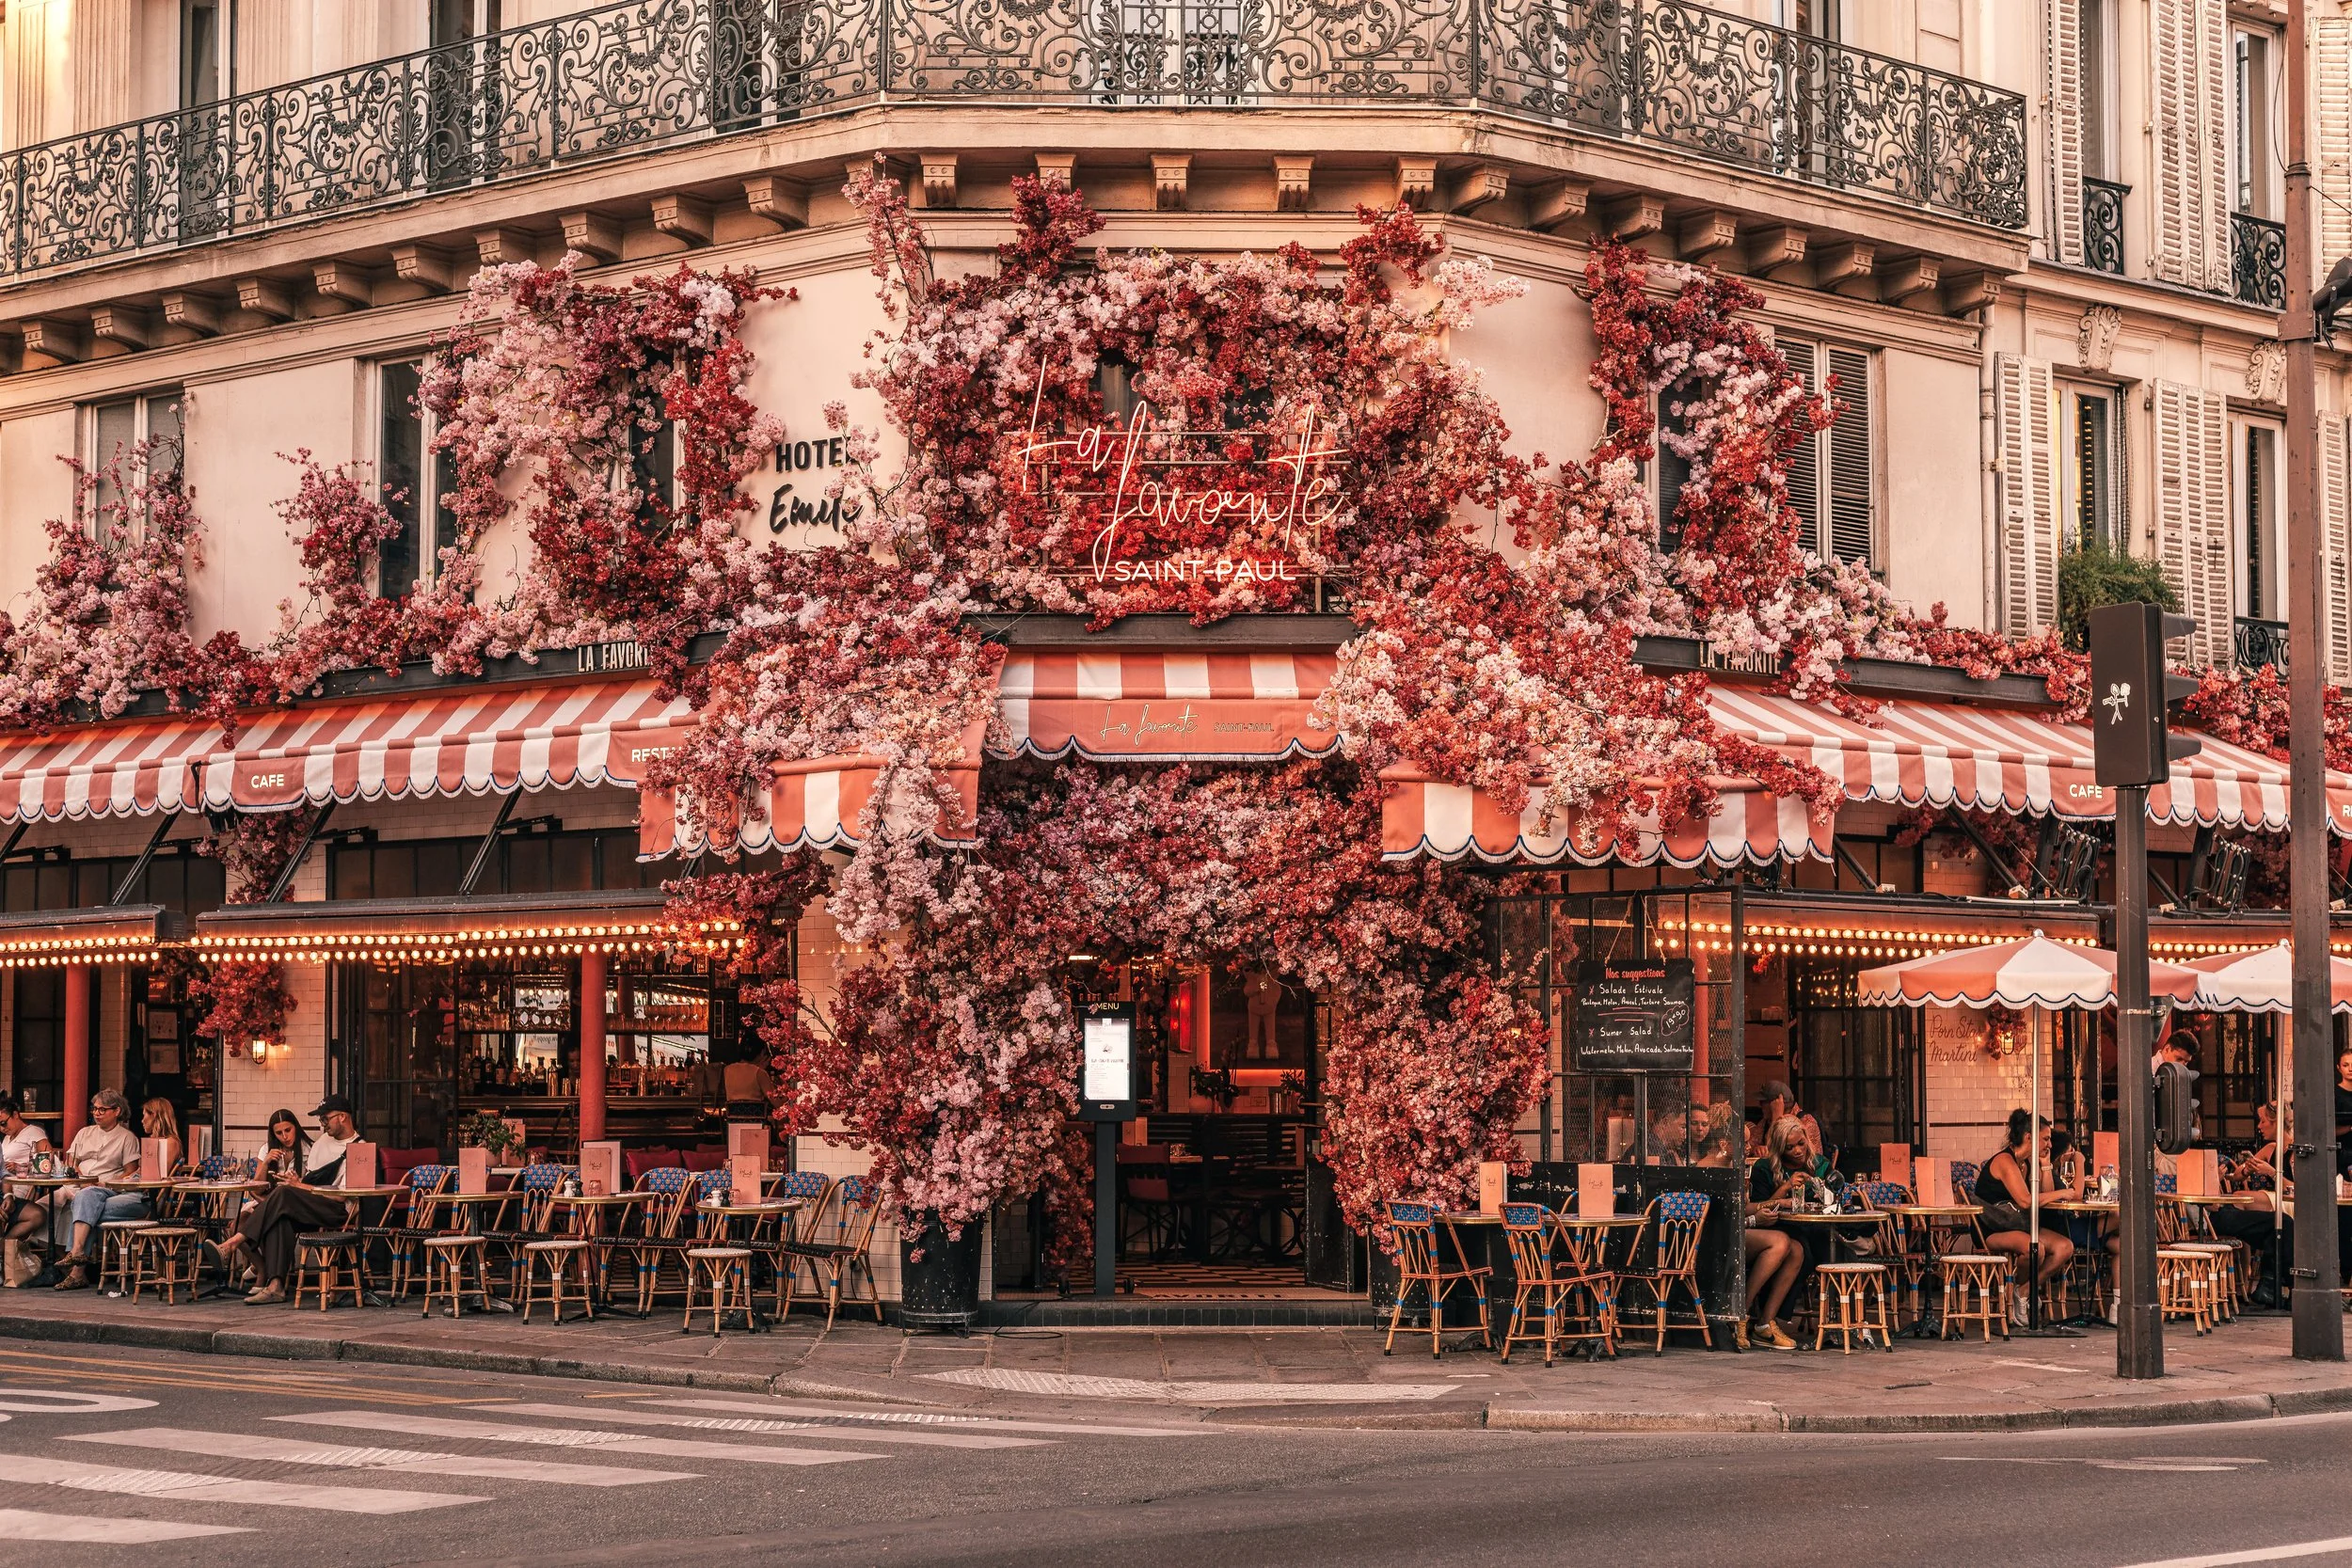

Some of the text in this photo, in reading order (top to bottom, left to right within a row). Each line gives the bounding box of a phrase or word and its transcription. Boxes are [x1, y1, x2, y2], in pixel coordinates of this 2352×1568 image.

[1016, 355, 1115, 492] La
[1114, 560, 1296, 582] SAINT-PAUL
[578, 641, 654, 673] LA FAVORI
[1699, 641, 1716, 668] LA
[1100, 705, 1131, 741] La
[1214, 722, 1274, 732] SAINT-PAUL
[250, 773, 284, 788] CAFE
[2069, 784, 2104, 799] CAFE
[1605, 967, 1665, 982] Nos suggestions
[1599, 983, 1663, 994] Salade Estivale
[1095, 1002, 1120, 1010] MENU
[1629, 1025, 1652, 1036] Salad
[1929, 1039, 1978, 1062] Martini
